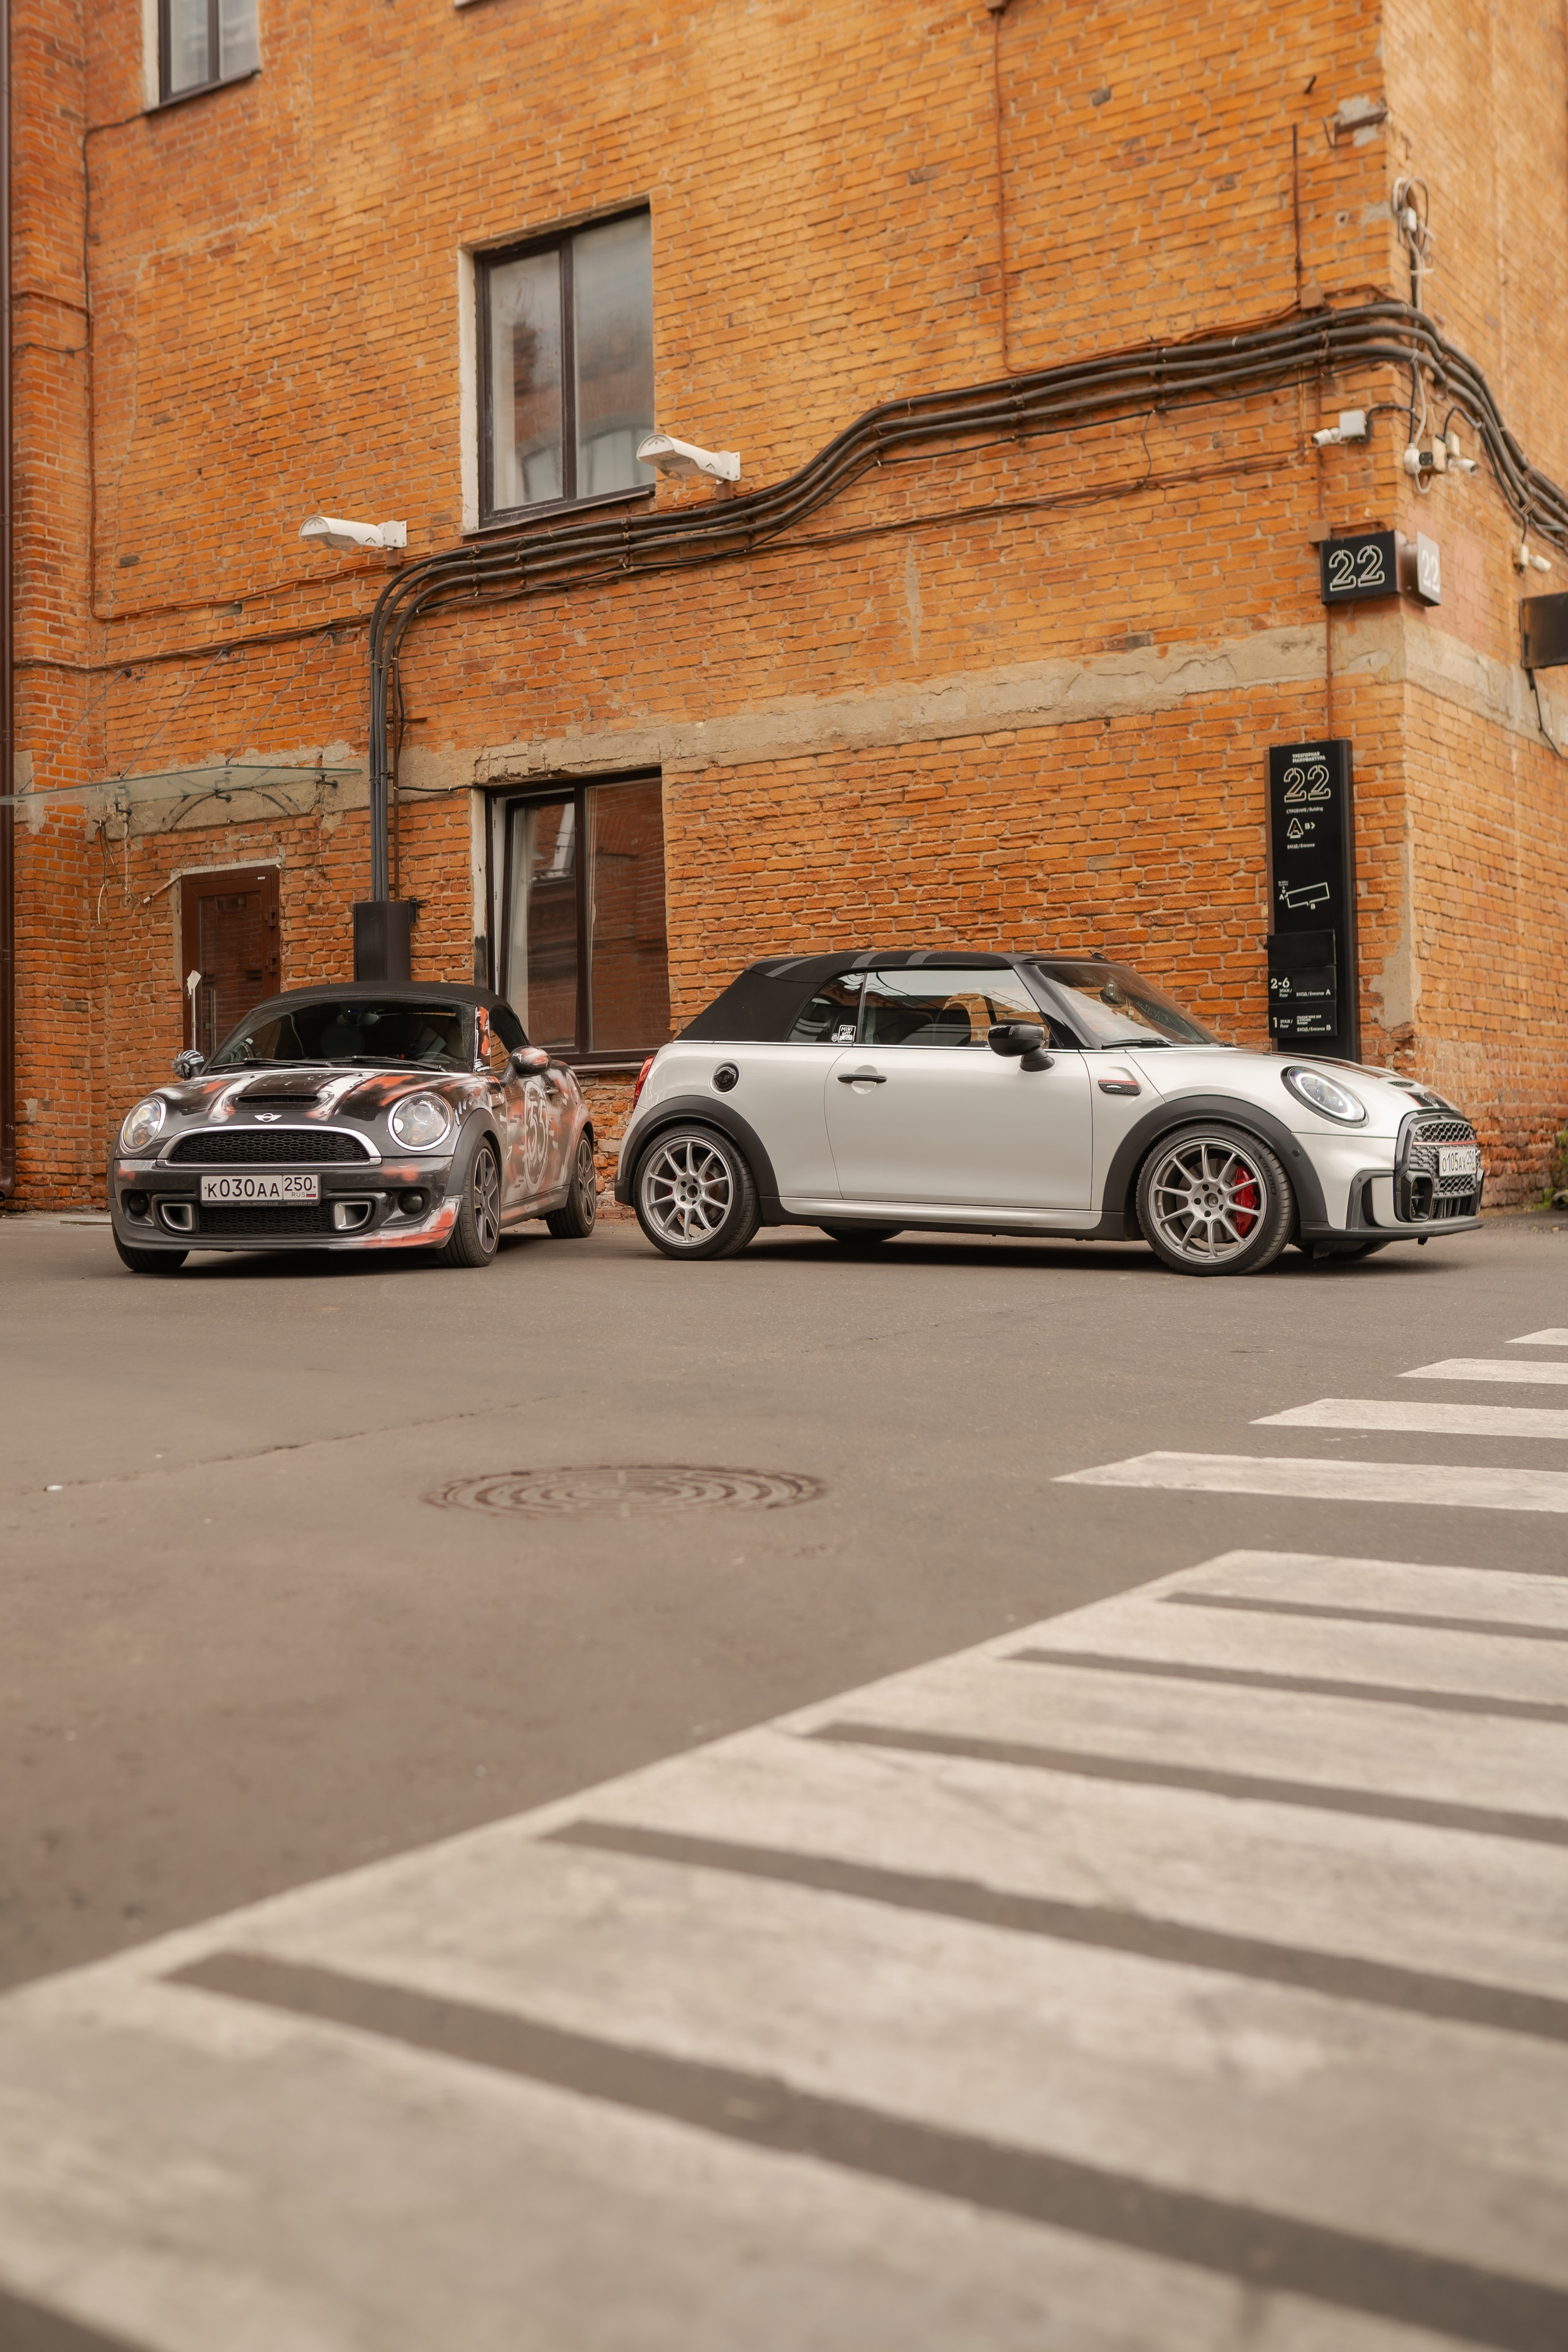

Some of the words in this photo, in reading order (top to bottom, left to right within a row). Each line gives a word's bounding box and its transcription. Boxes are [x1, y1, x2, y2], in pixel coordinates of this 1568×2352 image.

[1329, 545, 1385, 592] 22
[1422, 549, 1440, 593] 22
[1284, 764, 1331, 802] 22
[1270, 977, 1290, 989] 2-6
[1273, 1017, 1278, 1028] 1
[284, 1177, 312, 1191] 250
